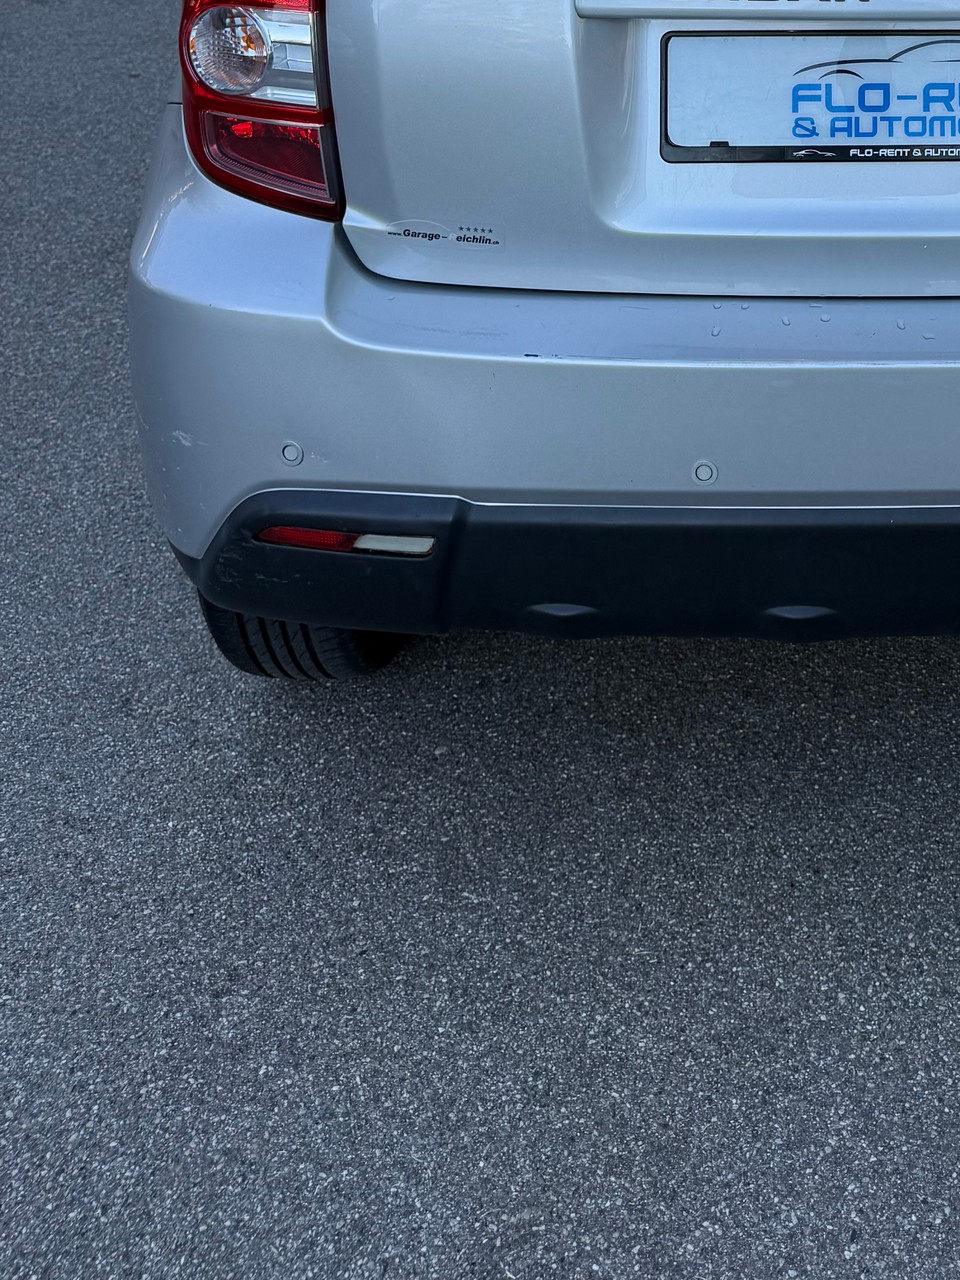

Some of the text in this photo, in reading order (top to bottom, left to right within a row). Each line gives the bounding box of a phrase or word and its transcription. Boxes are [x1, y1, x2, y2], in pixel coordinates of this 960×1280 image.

[792, 116, 819, 138] &
[850, 148, 910, 157] FLO-RENT
[913, 149, 921, 157] &
